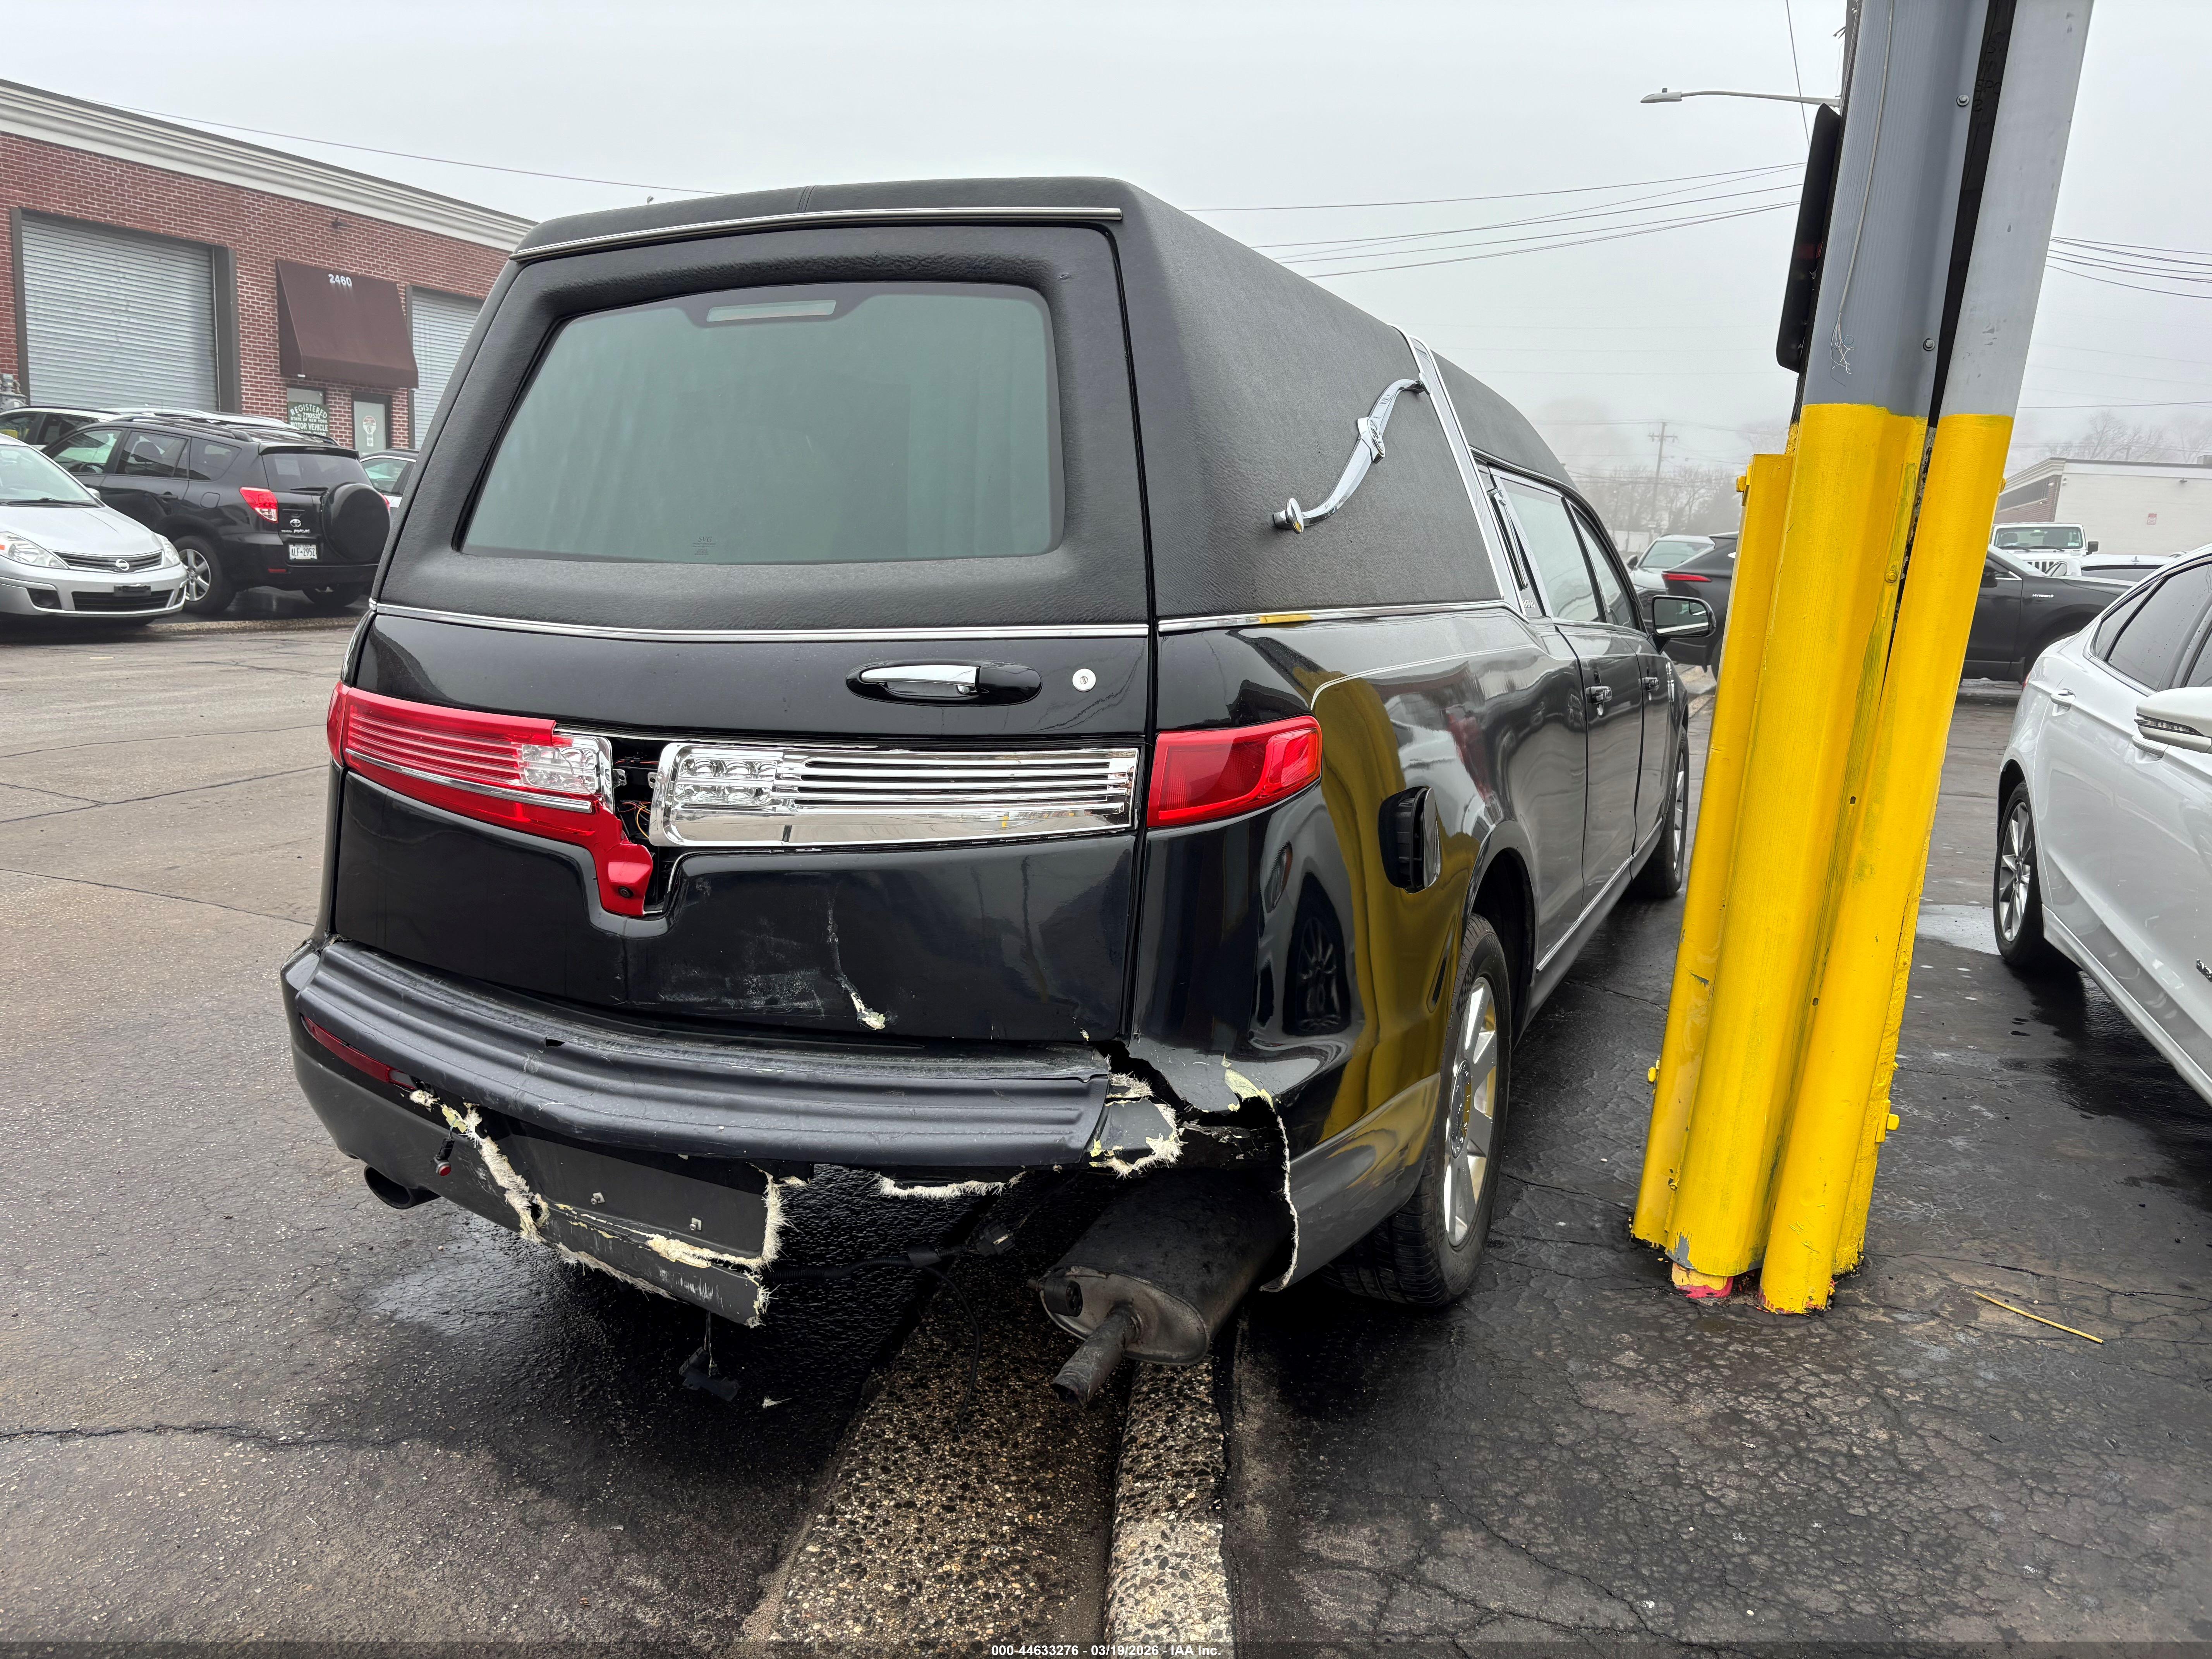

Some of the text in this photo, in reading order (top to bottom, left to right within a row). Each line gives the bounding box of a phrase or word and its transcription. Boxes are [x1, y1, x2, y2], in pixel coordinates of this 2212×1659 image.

[328, 273, 352, 287] 2460
[290, 404, 327, 418] REGISTERED
[290, 421, 328, 431] MOTOR VEHICLE
